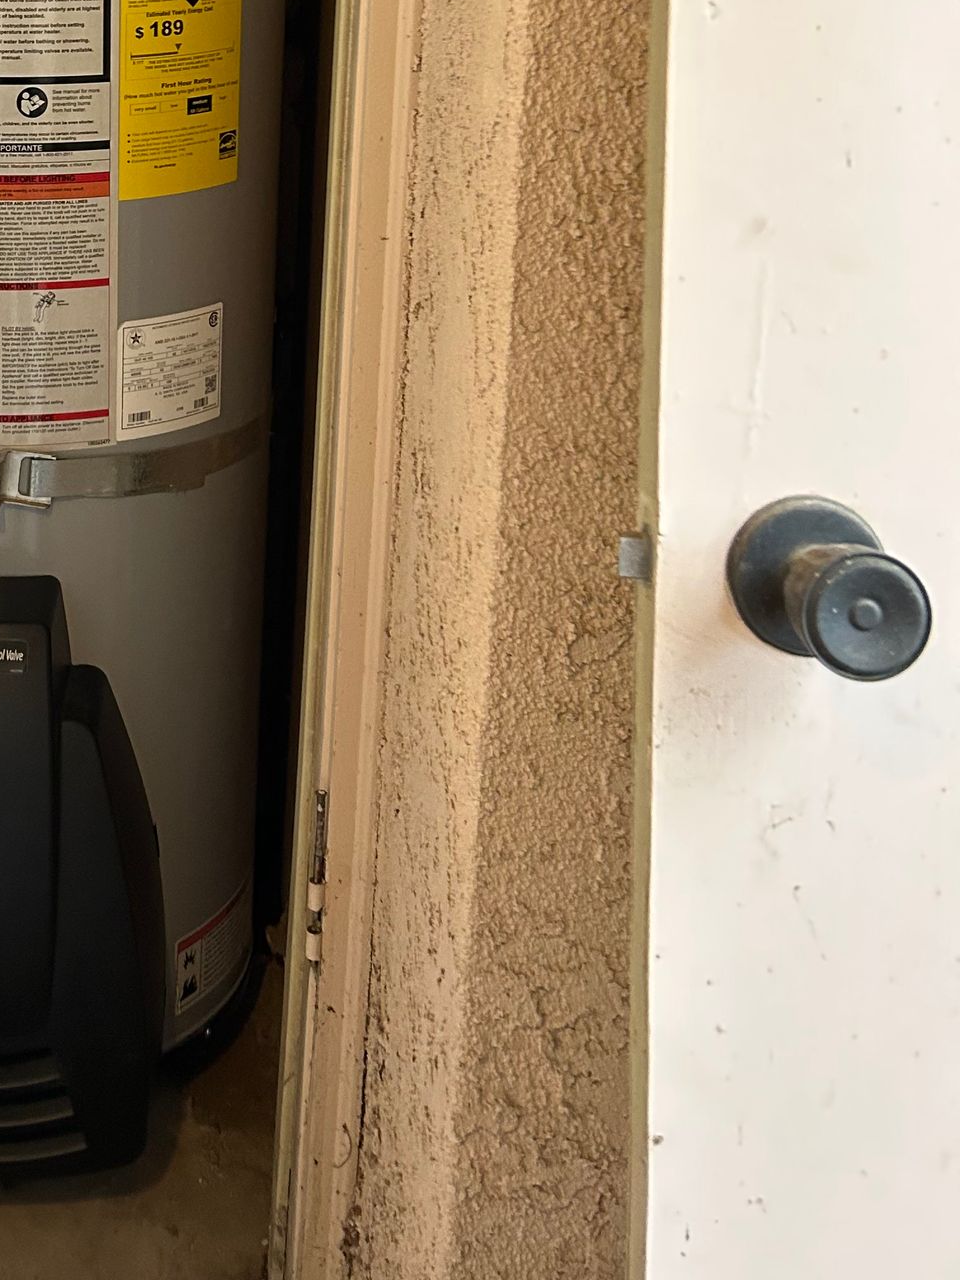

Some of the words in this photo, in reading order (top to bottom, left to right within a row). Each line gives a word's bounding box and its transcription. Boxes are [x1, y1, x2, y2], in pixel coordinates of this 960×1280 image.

[135, 26, 144, 39] $
[150, 20, 184, 37] 189
[6, 649, 23, 661] Valve
